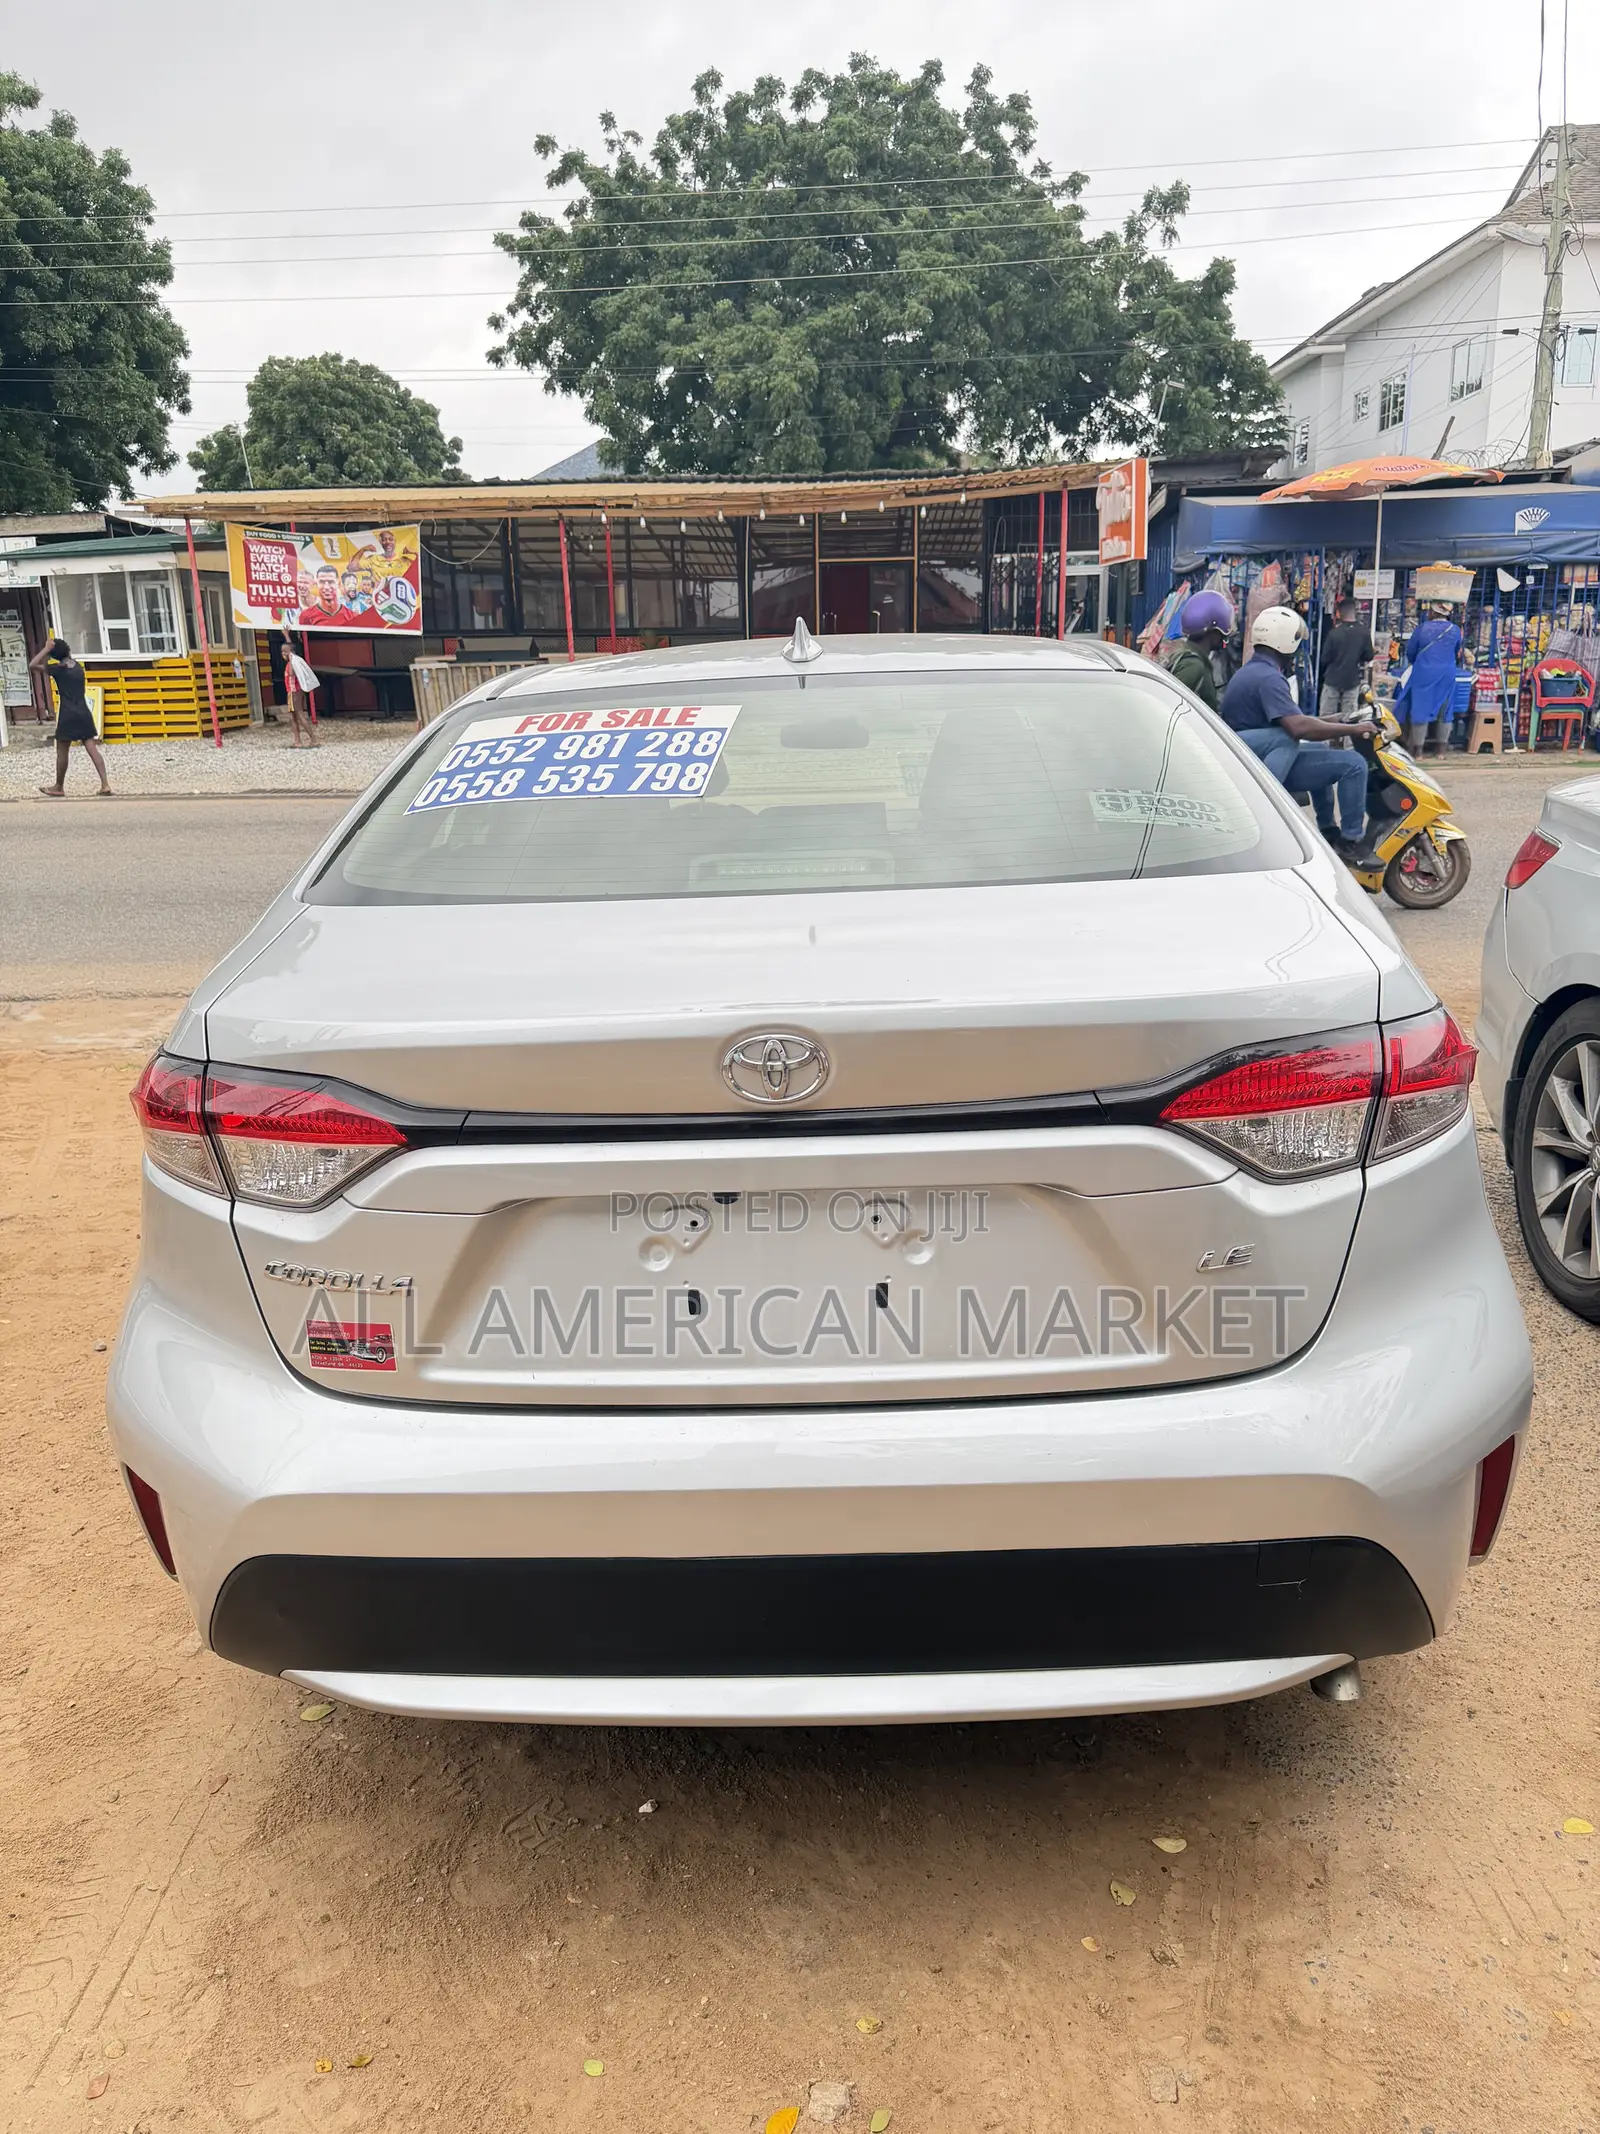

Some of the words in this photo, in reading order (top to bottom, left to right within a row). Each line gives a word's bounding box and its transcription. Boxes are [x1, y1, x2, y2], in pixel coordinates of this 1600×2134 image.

[248, 544, 286, 554] WATCH
[250, 554, 286, 564] EVERY
[250, 562, 288, 572] MATCH
[252, 572, 279, 582] HERE
[281, 574, 292, 584] @
[248, 584, 296, 598] TULUS
[514, 712, 593, 734] FOR
[600, 707, 702, 729] SALE
[437, 737, 547, 773] 0552
[553, 732, 631, 760] 981
[635, 730, 722, 757] 288
[414, 768, 526, 807] 0558
[532, 763, 620, 794] 535
[627, 762, 709, 792] 798
[1196, 1243, 1255, 1273] LE
[264, 1259, 413, 1296] COROLLA
